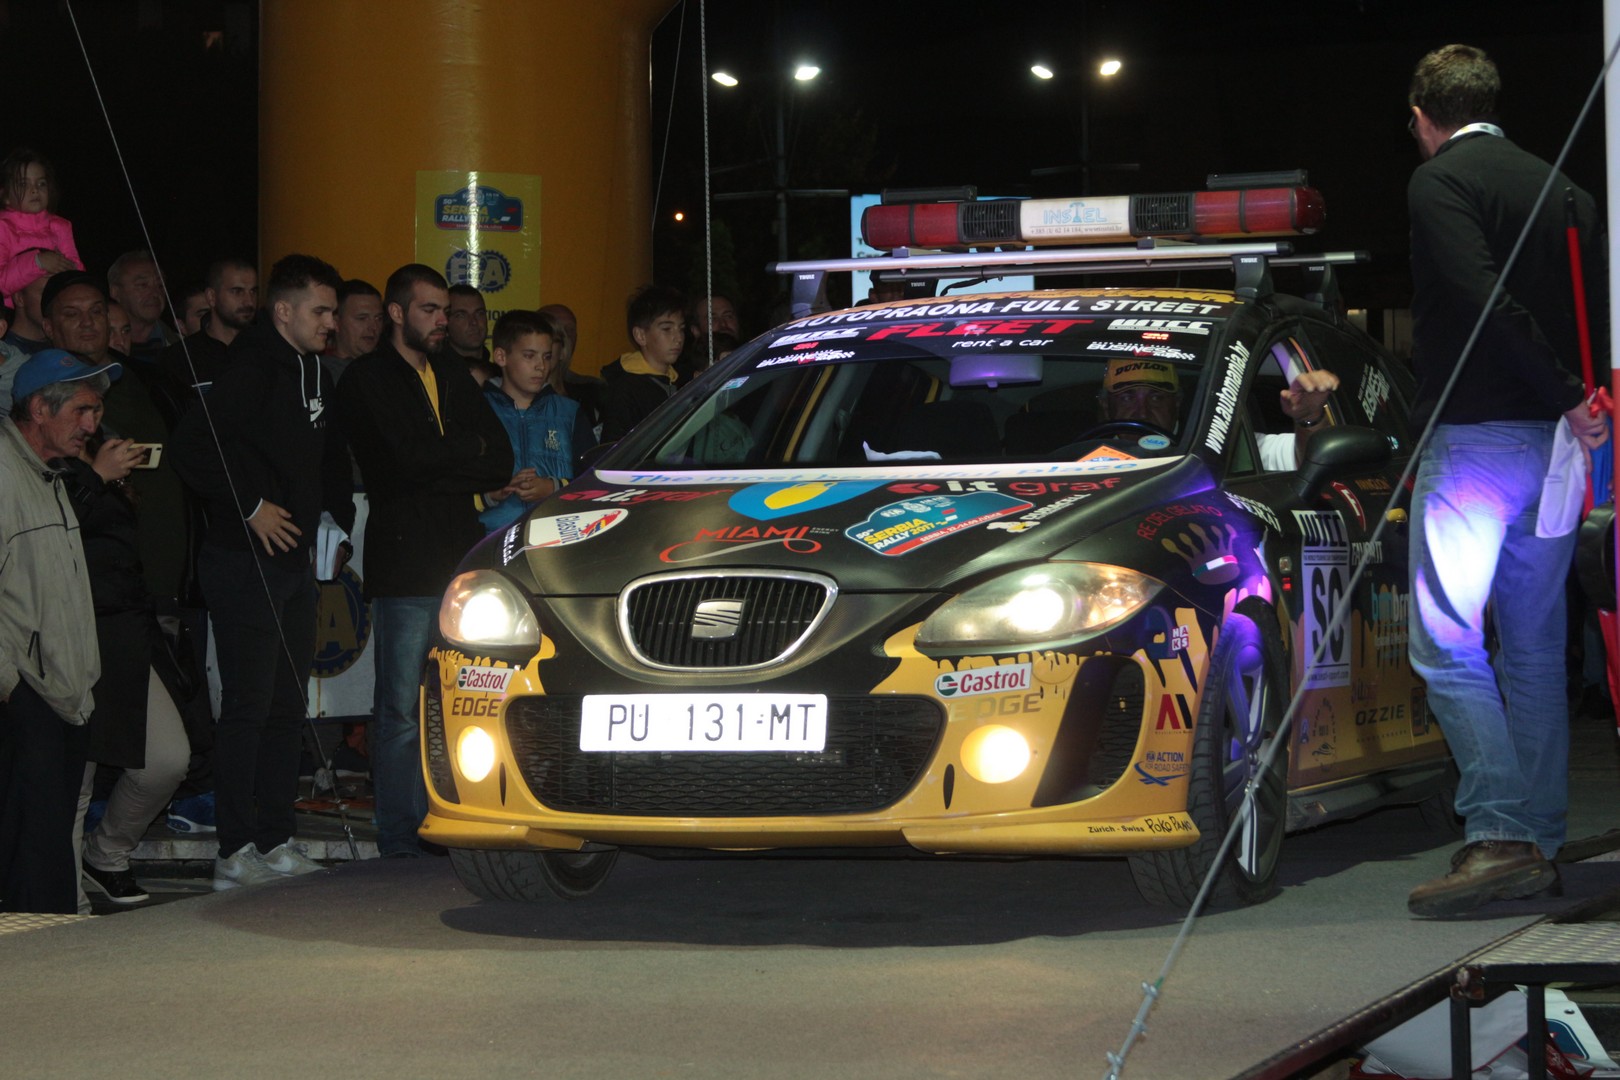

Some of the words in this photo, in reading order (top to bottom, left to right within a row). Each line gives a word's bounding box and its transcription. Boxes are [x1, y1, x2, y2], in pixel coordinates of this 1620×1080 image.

[1043, 202, 1107, 224] INSTEL
[784, 301, 996, 330] AUTOPRAONA
[1001, 299, 1081, 313] FULL
[1090, 299, 1222, 314] STREET
[865, 319, 1095, 341] FLEET
[1107, 319, 1213, 335] WTCC
[1142, 332, 1170, 341] 3M
[952, 338, 994, 348] rent
[1000, 339, 1013, 347] a
[1019, 338, 1053, 347] car
[1115, 362, 1170, 377] DUNLOP
[1205, 340, 1251, 455] www.automania.hr
[630, 474, 693, 484] The
[704, 474, 804, 482] most
[1018, 463, 1138, 475] place
[1008, 477, 1121, 496] graf
[1145, 511, 1175, 527] DEL
[1166, 504, 1223, 517] GELATO
[693, 526, 810, 541] MIAMI
[863, 518, 928, 545] SERBIA
[873, 530, 911, 550] RALLY
[911, 521, 936, 535] 2017
[1137, 522, 1157, 541] RE
[466, 669, 507, 690] Castrol
[960, 668, 1026, 694] Castrol
[452, 697, 502, 717] EDGE
[949, 693, 1042, 721] EDGE
[1355, 704, 1405, 726] OZZIE
[608, 703, 650, 742] PU
[1157, 752, 1184, 763] ACTION
[1154, 764, 1171, 773] ROAD
[1121, 825, 1145, 833] Swiss
